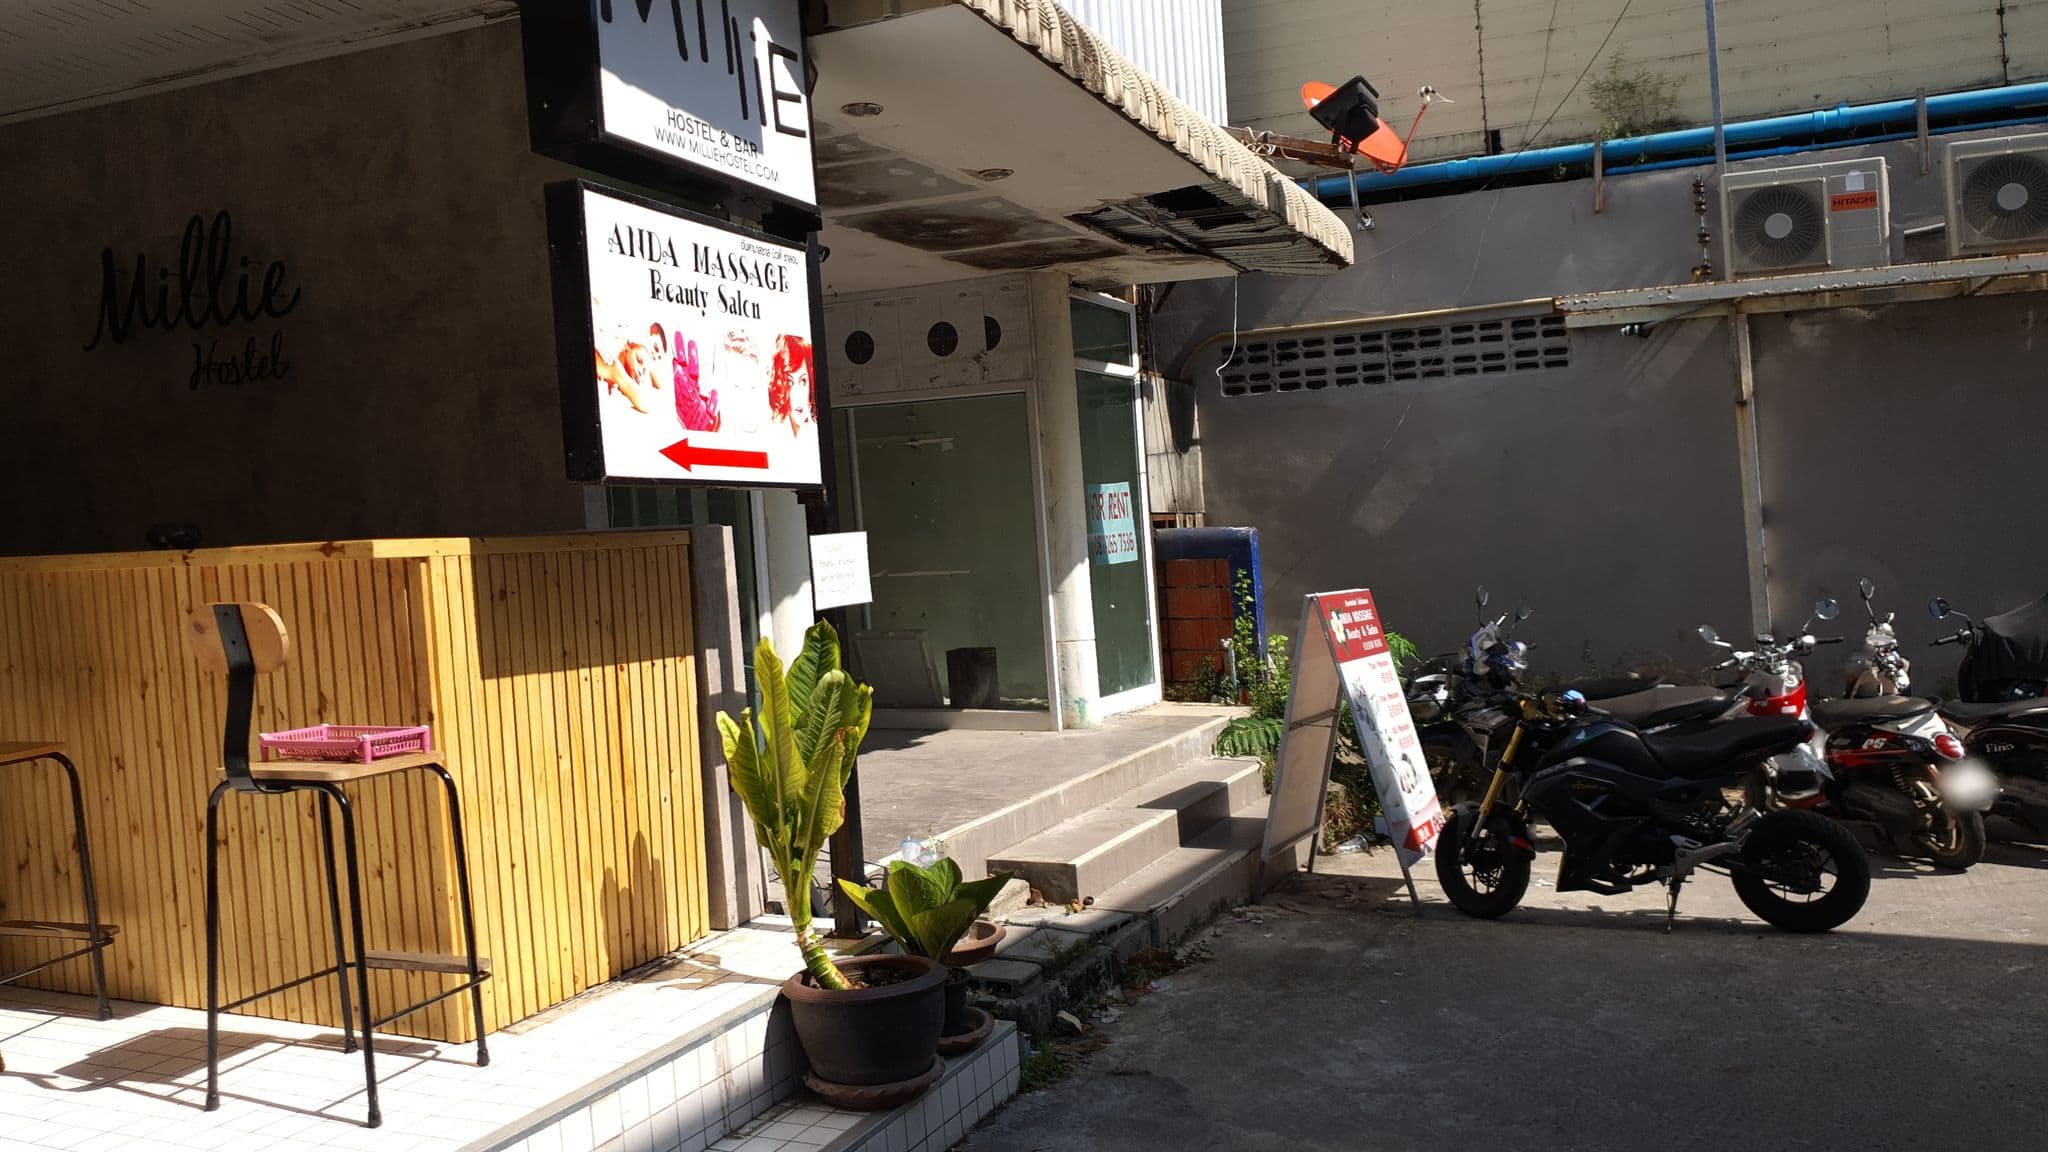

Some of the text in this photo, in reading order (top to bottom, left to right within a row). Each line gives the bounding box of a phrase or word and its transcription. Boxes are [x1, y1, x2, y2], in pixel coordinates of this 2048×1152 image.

[667, 109, 758, 159] HOSTEL & BAR
[1831, 195, 1876, 206] HITACHI
[82, 210, 302, 352] Millie
[608, 222, 679, 268] ANDA
[691, 242, 791, 294] MASSAGE
[649, 269, 709, 317] Beauty
[189, 330, 291, 391] Hostel
[1108, 491, 1129, 520] RENT
